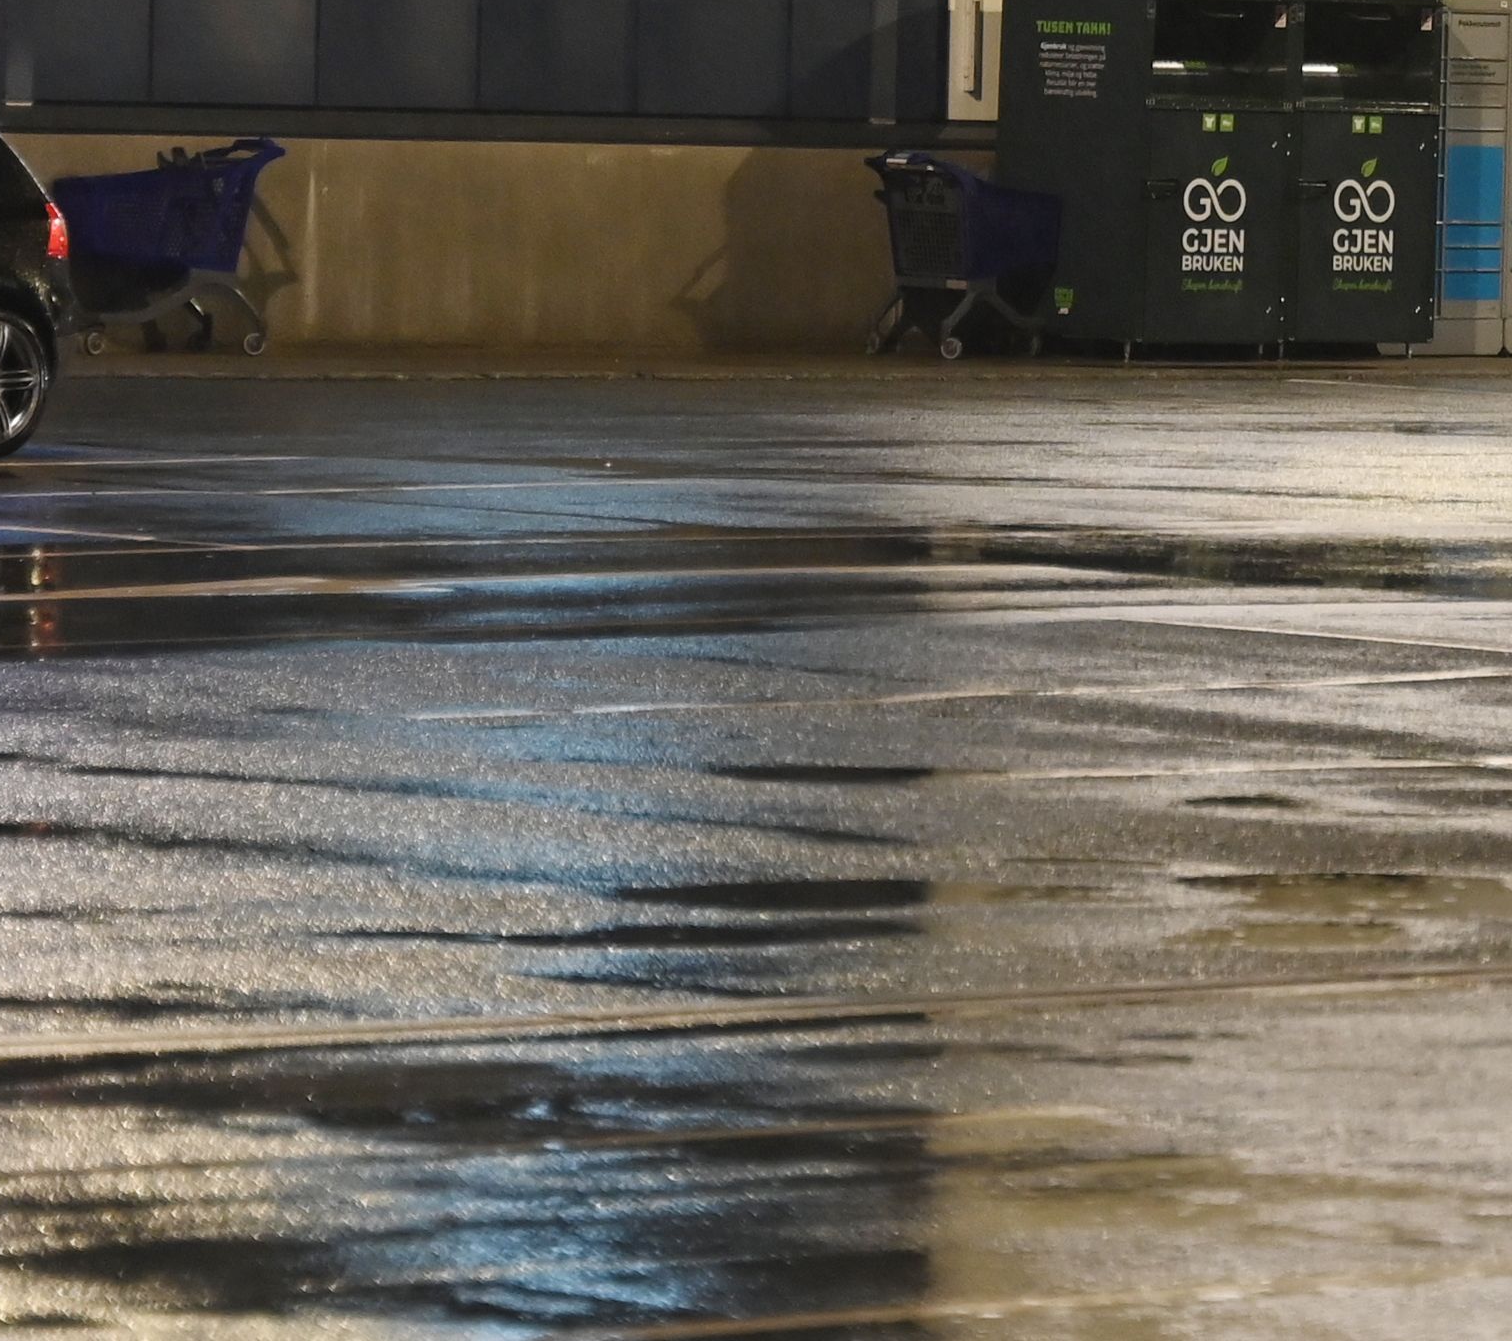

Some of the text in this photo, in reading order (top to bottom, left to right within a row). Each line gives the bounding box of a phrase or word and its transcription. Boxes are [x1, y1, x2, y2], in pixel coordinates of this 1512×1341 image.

[1036, 20, 1074, 34] TUSEN
[1183, 177, 1247, 223] GO
[1333, 178, 1396, 223] GO
[1182, 228, 1245, 254] GJEN
[1333, 228, 1394, 254] GJEN
[1182, 255, 1244, 272] BRUKEN
[1333, 255, 1393, 273] BRUKEN
